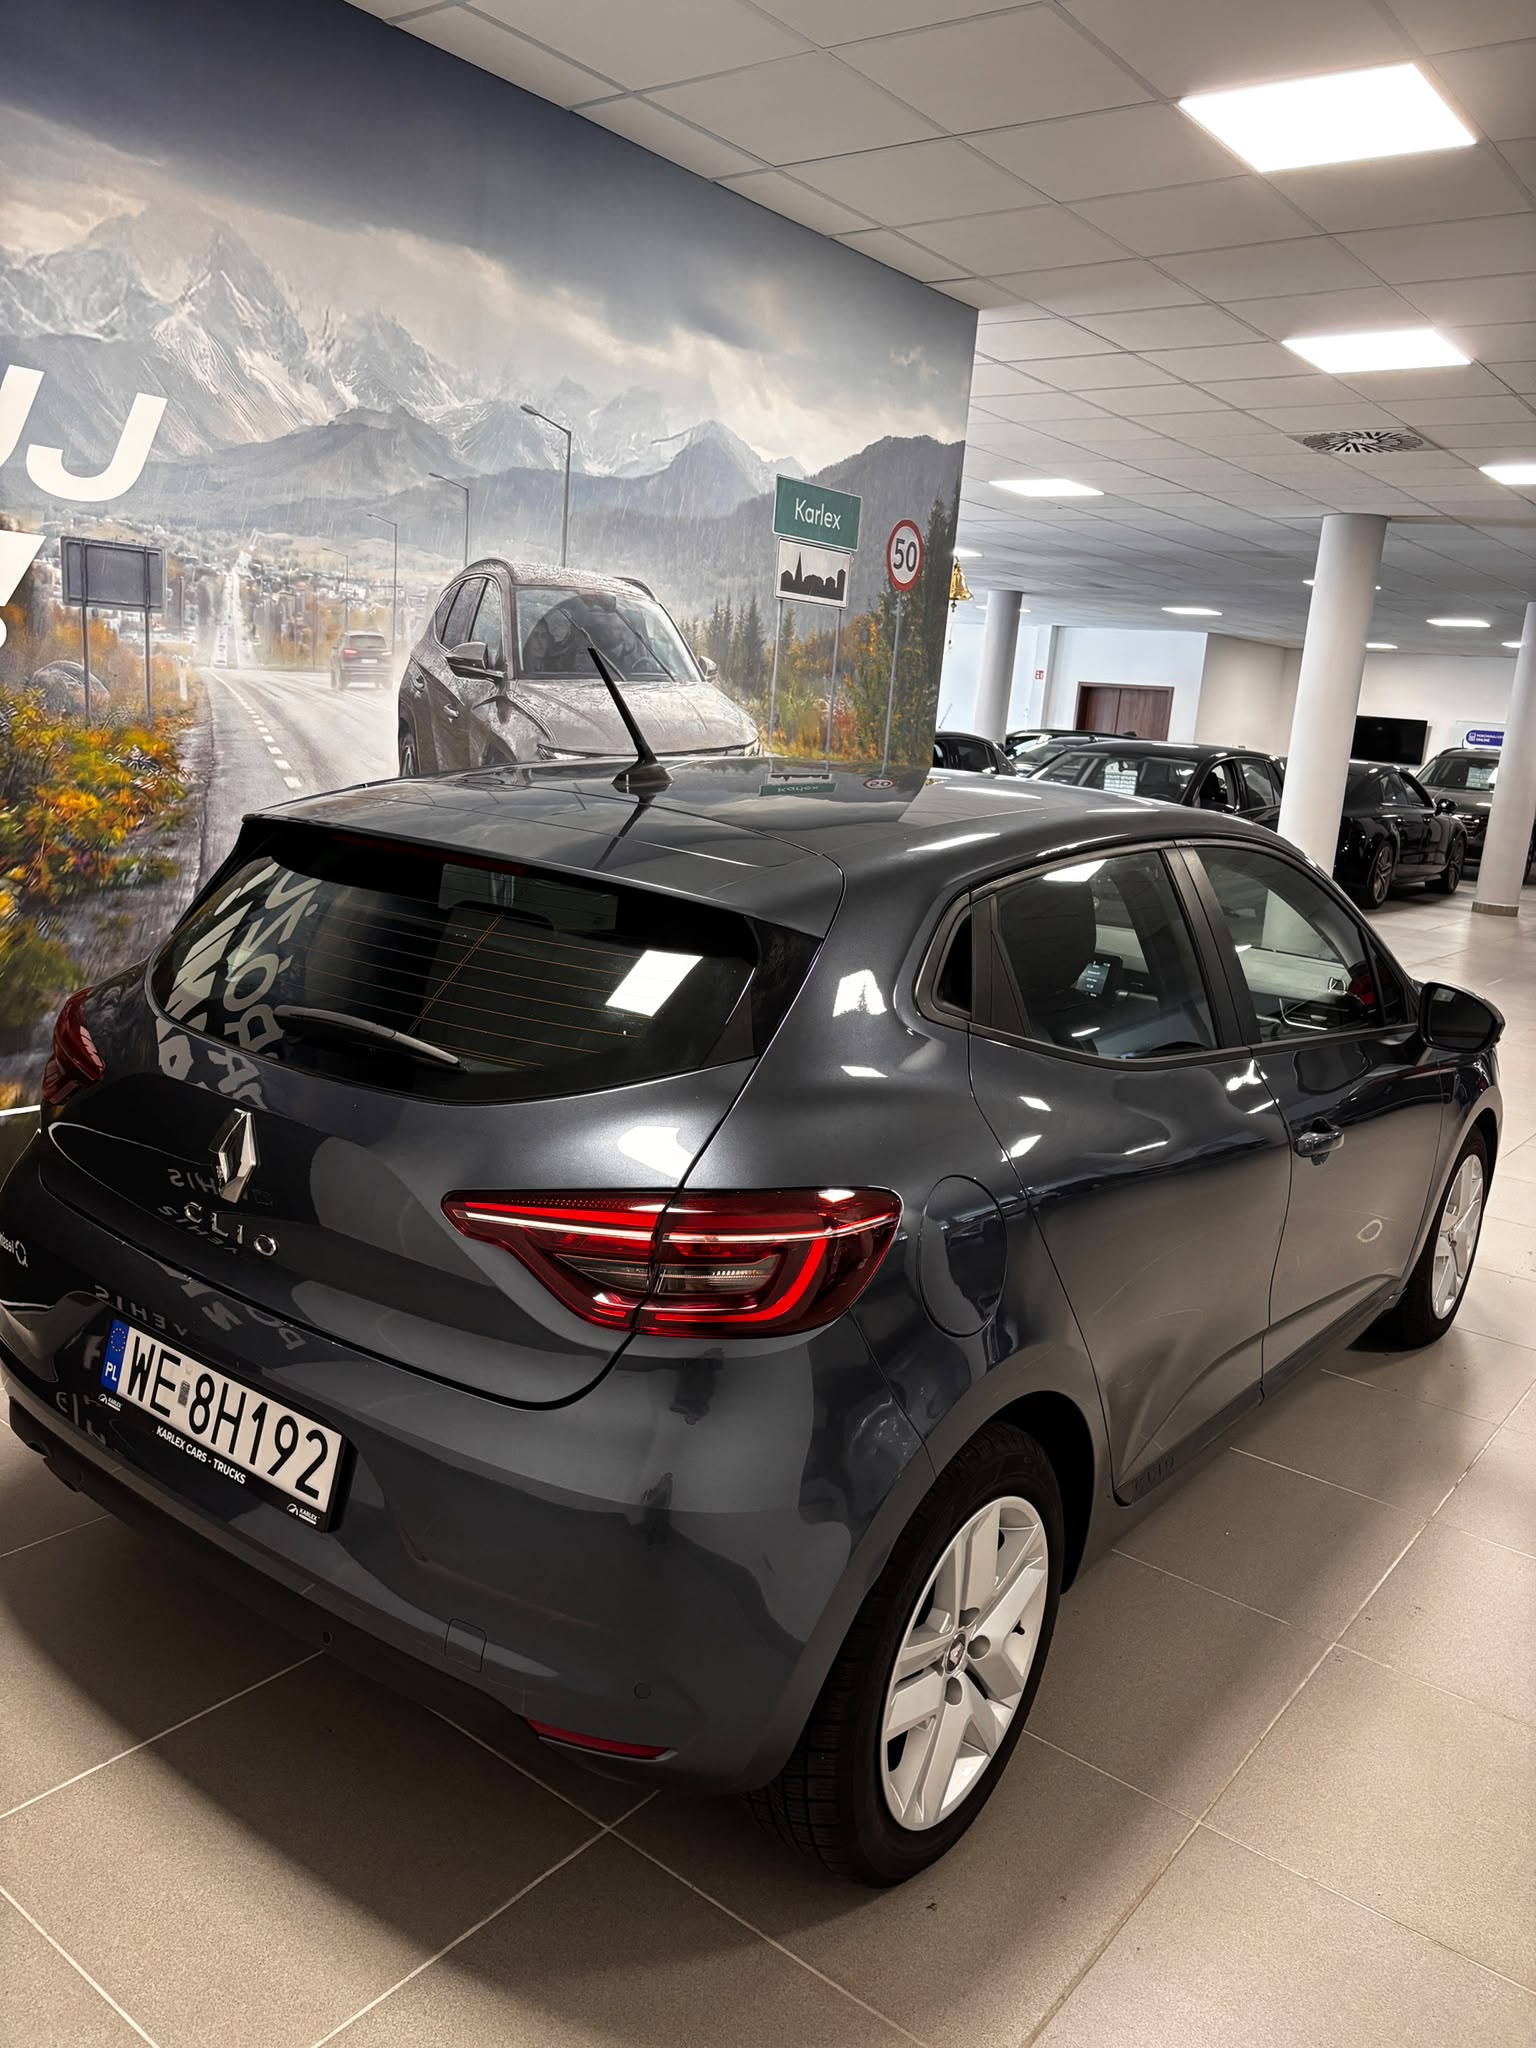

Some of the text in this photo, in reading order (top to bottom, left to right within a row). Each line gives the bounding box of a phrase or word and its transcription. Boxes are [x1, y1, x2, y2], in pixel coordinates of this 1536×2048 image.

[794, 497, 842, 531] Karlex
[892, 537, 918, 573] 50
[183, 1201, 277, 1257] CLIO
[104, 1360, 118, 1382] PL
[127, 1335, 182, 1419] WE
[188, 1373, 329, 1501] 8H192
[156, 1425, 185, 1451] KARLEX
[185, 1443, 208, 1464] CARS
[212, 1458, 247, 1485] TRUCKS
[299, 1507, 319, 1522] KARLEX
